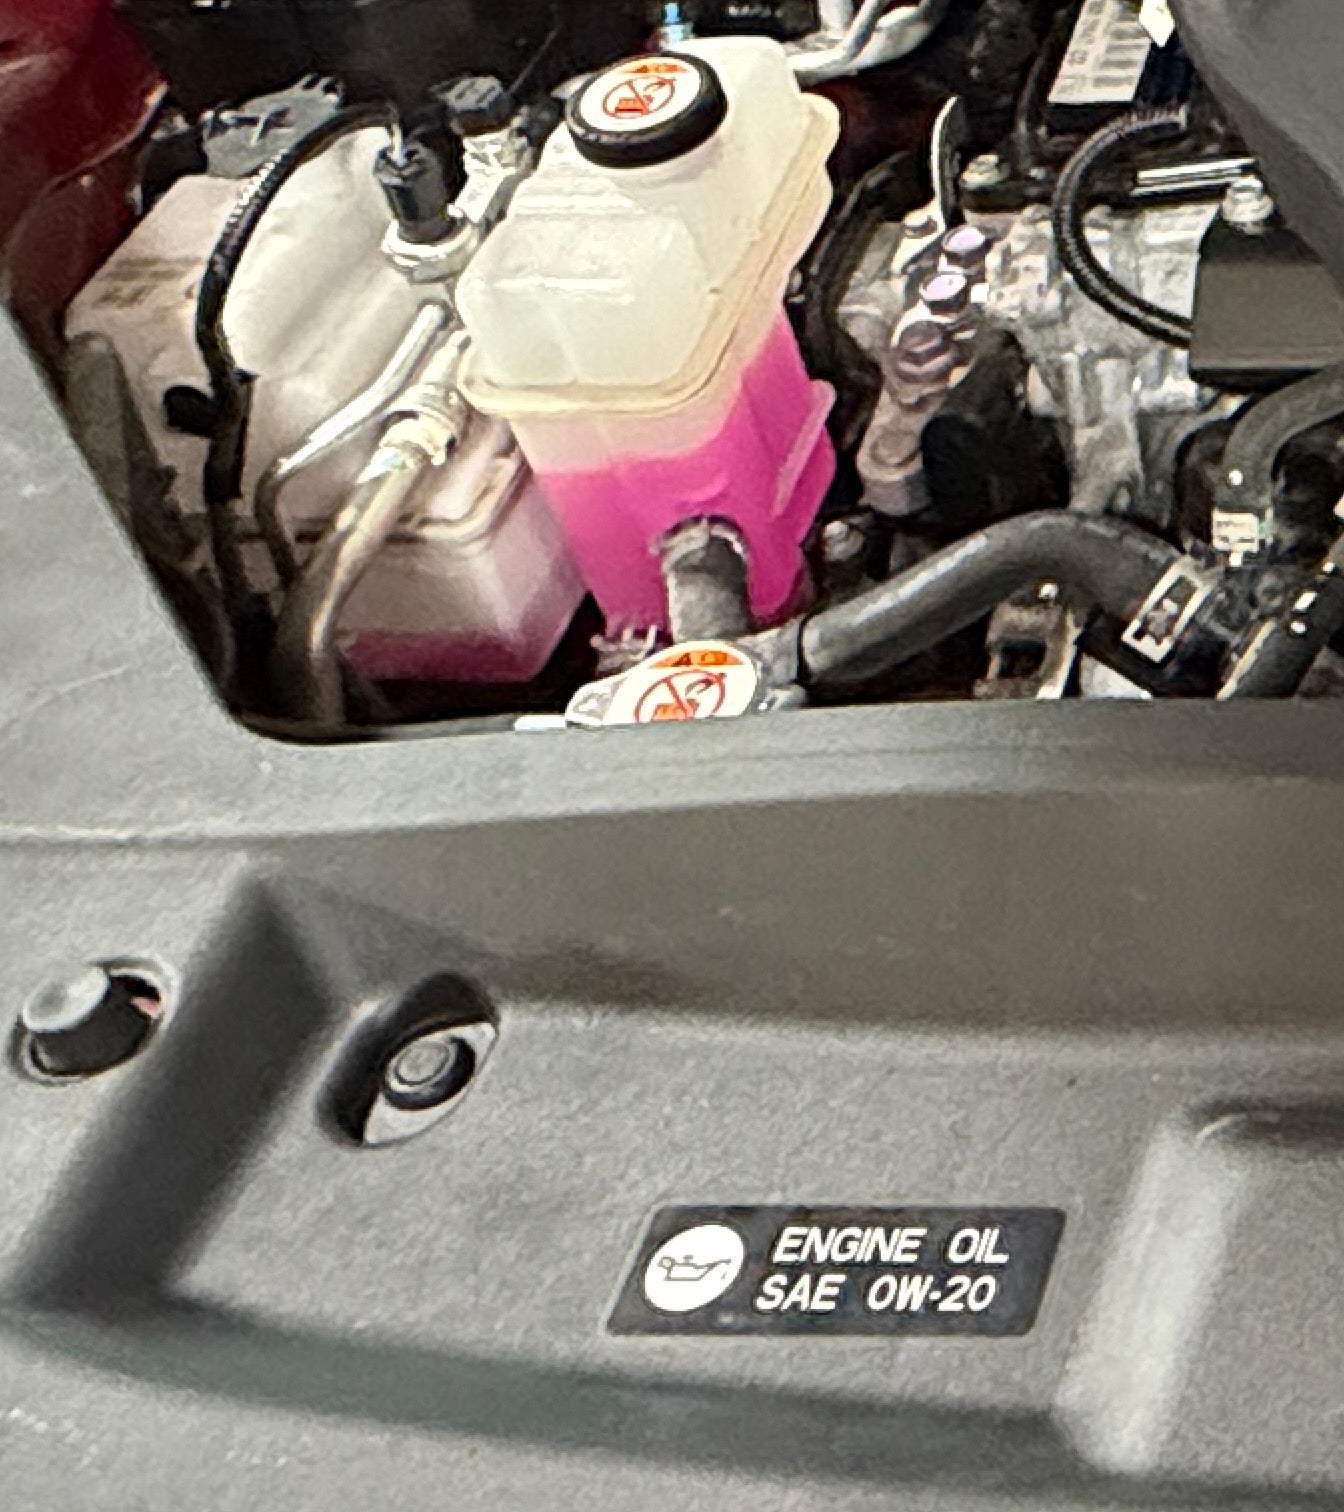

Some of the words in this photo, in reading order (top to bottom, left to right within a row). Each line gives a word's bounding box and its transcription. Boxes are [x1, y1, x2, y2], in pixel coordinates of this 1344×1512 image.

[772, 1226, 928, 1263] ENGINE
[947, 1226, 1010, 1263] OIL
[755, 1274, 847, 1311] SAE
[866, 1275, 997, 1311] 0W-20
